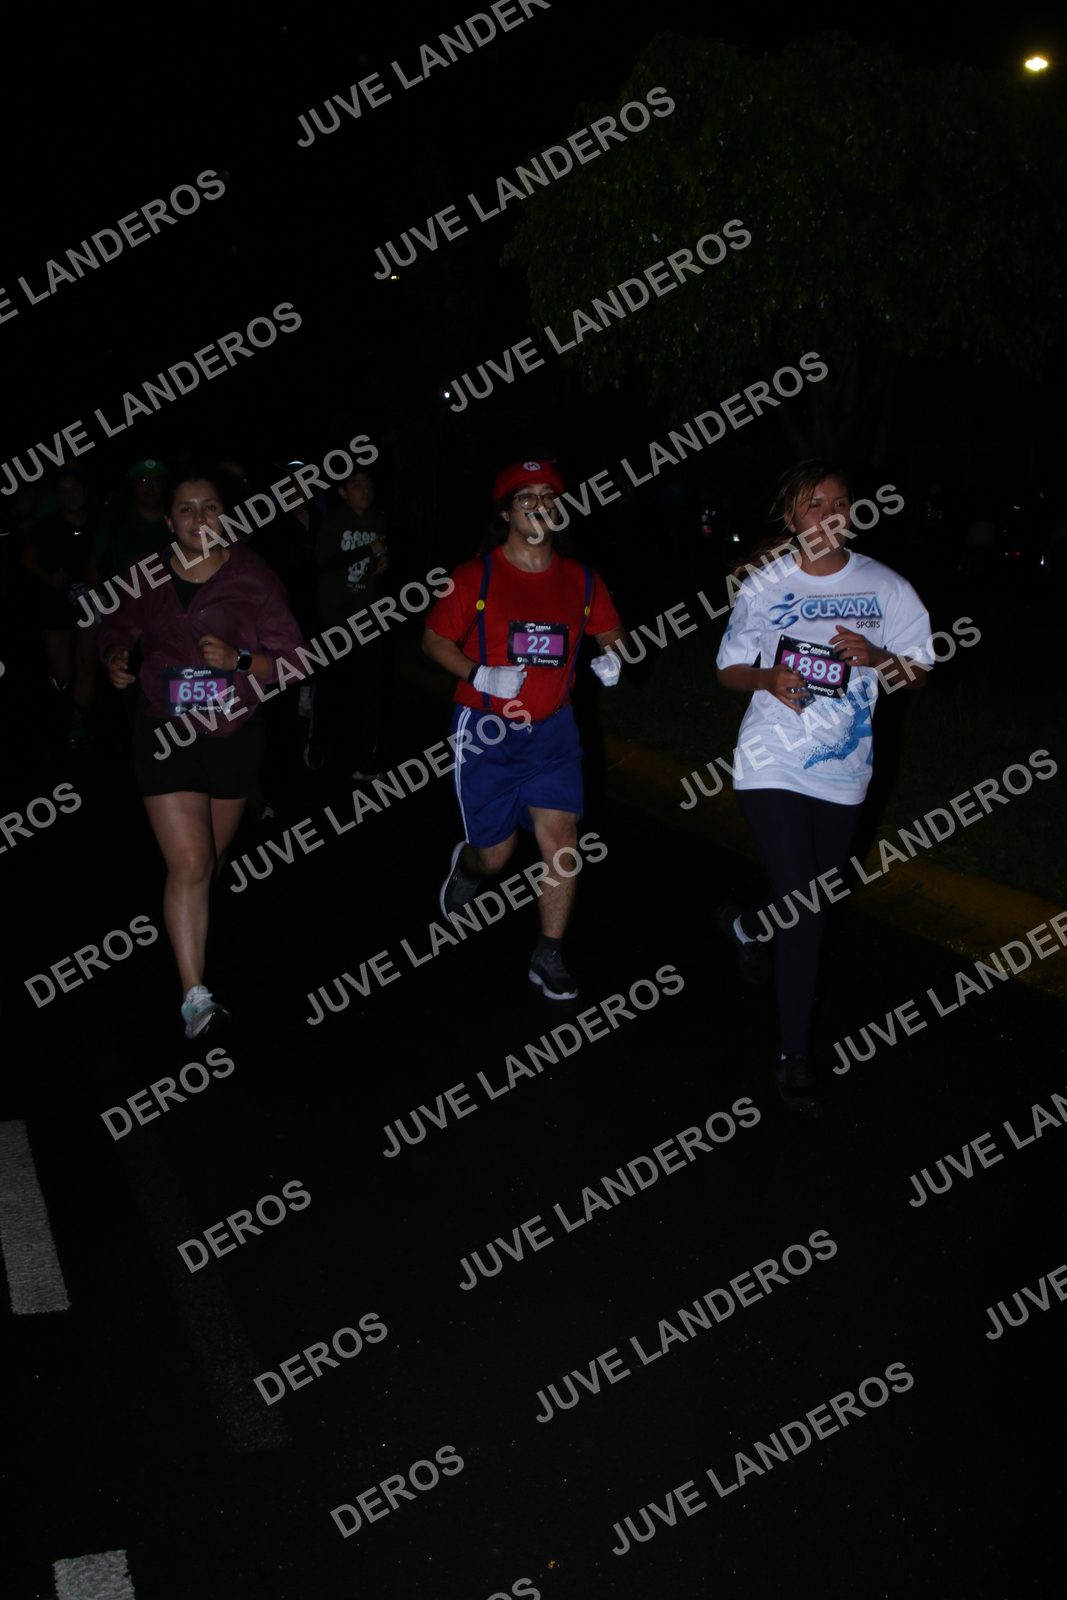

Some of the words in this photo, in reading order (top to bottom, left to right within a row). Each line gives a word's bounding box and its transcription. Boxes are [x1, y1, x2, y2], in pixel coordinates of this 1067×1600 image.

[801, 597, 881, 620] GUEVARA
[855, 620, 881, 629] SPORTS
[527, 635, 550, 654] 22
[784, 653, 842, 684] 1898
[179, 680, 219, 702] 653
